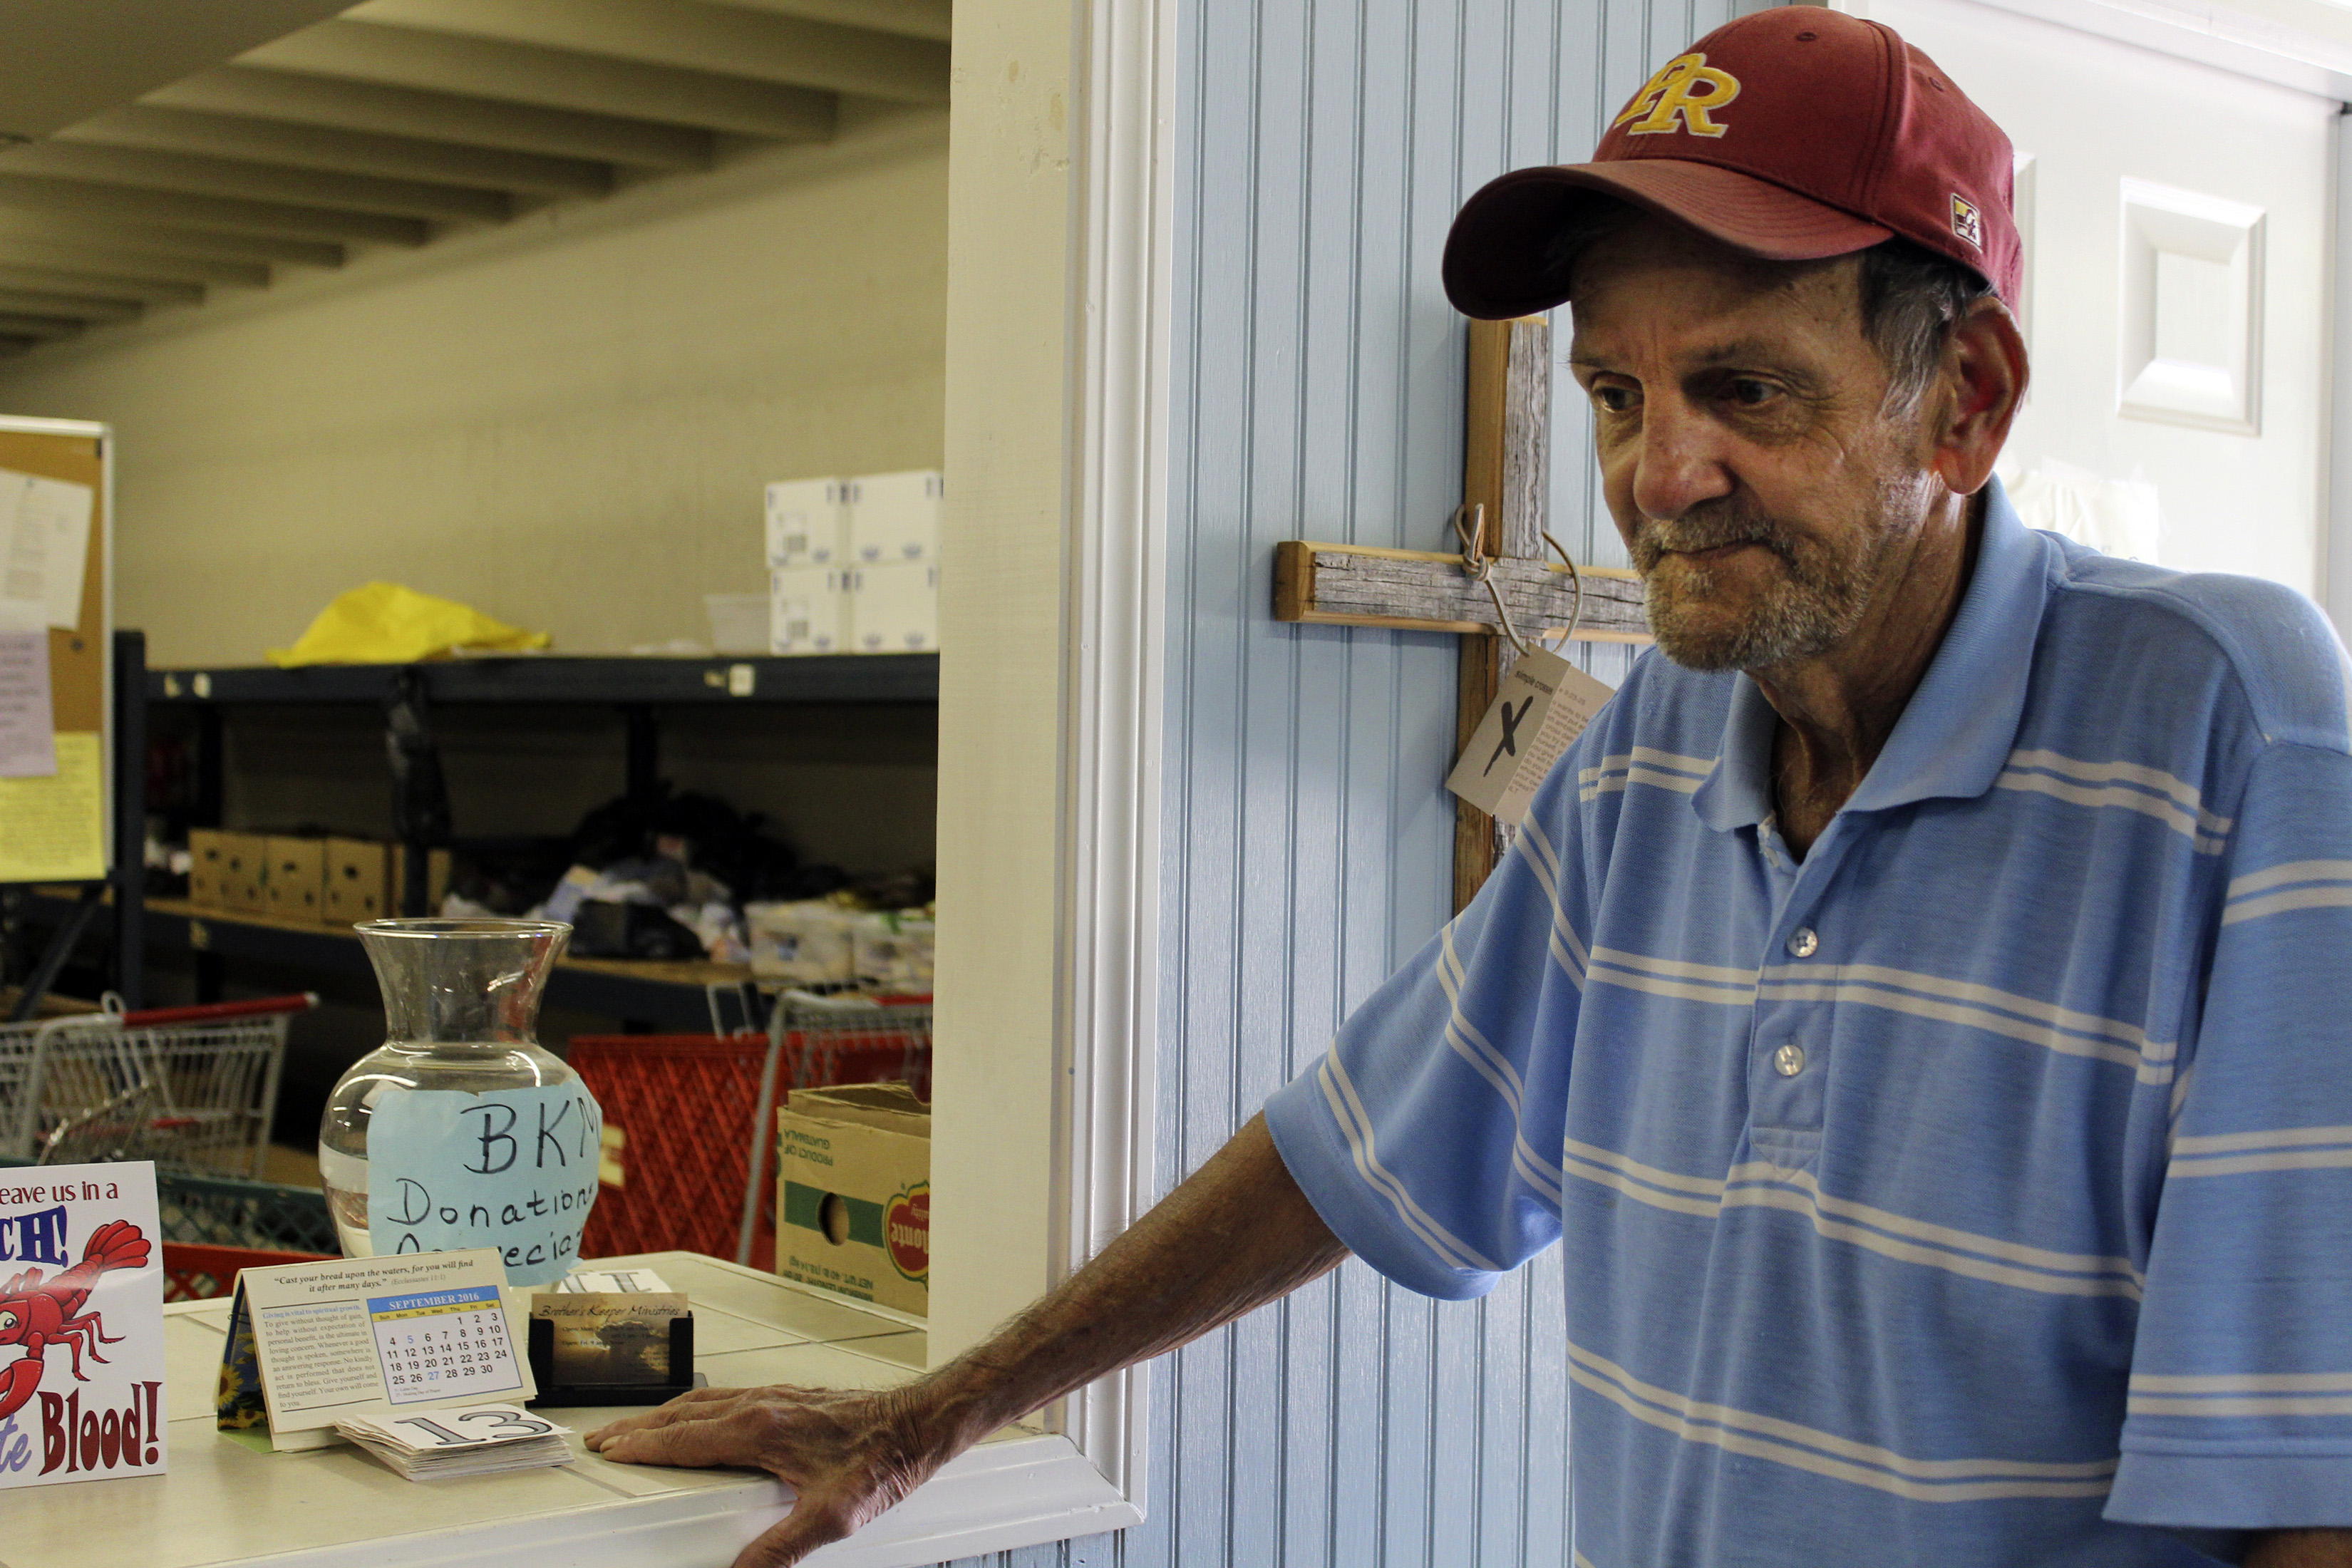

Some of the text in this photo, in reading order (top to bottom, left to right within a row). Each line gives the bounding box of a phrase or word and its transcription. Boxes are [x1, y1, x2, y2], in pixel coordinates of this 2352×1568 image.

[799, 1147, 833, 1166] PRODUCT
[53, 1182, 76, 1202] us
[82, 1180, 99, 1201] in
[106, 1182, 118, 1199] a
[386, 1177, 594, 1228] Donation
[300, 1275, 318, 1284] your
[321, 1272, 343, 1281] bread
[345, 1271, 365, 1279] upon
[411, 1265, 423, 1274] for
[458, 1259, 473, 1269] find
[317, 1284, 336, 1293] after
[339, 1282, 359, 1291] many
[389, 1293, 479, 1310] SEPTEMBER 2016
[587, 1305, 625, 1322] Keeper
[629, 1305, 680, 1316] Ministries
[320, 1322, 356, 1331] expectation
[407, 1335, 413, 1343] 5
[425, 1333, 431, 1341] 6
[442, 1331, 448, 1339] 7
[489, 1325, 500, 1334] 10
[268, 1337, 294, 1346] personal
[405, 1348, 417, 1357] 12
[422, 1346, 434, 1355] 13
[492, 1337, 502, 1346] 17
[330, 1347, 363, 1356] somewhere
[391, 1349, 507, 1371] 18 19 20 21 22 23 24
[296, 1370, 329, 1380] performed
[339, 1374, 364, 1383] yourself
[393, 1364, 492, 1384] 25 26 27 28 29 30
[36, 1381, 163, 1477] Blood!
[393, 1410, 552, 1445] 13
